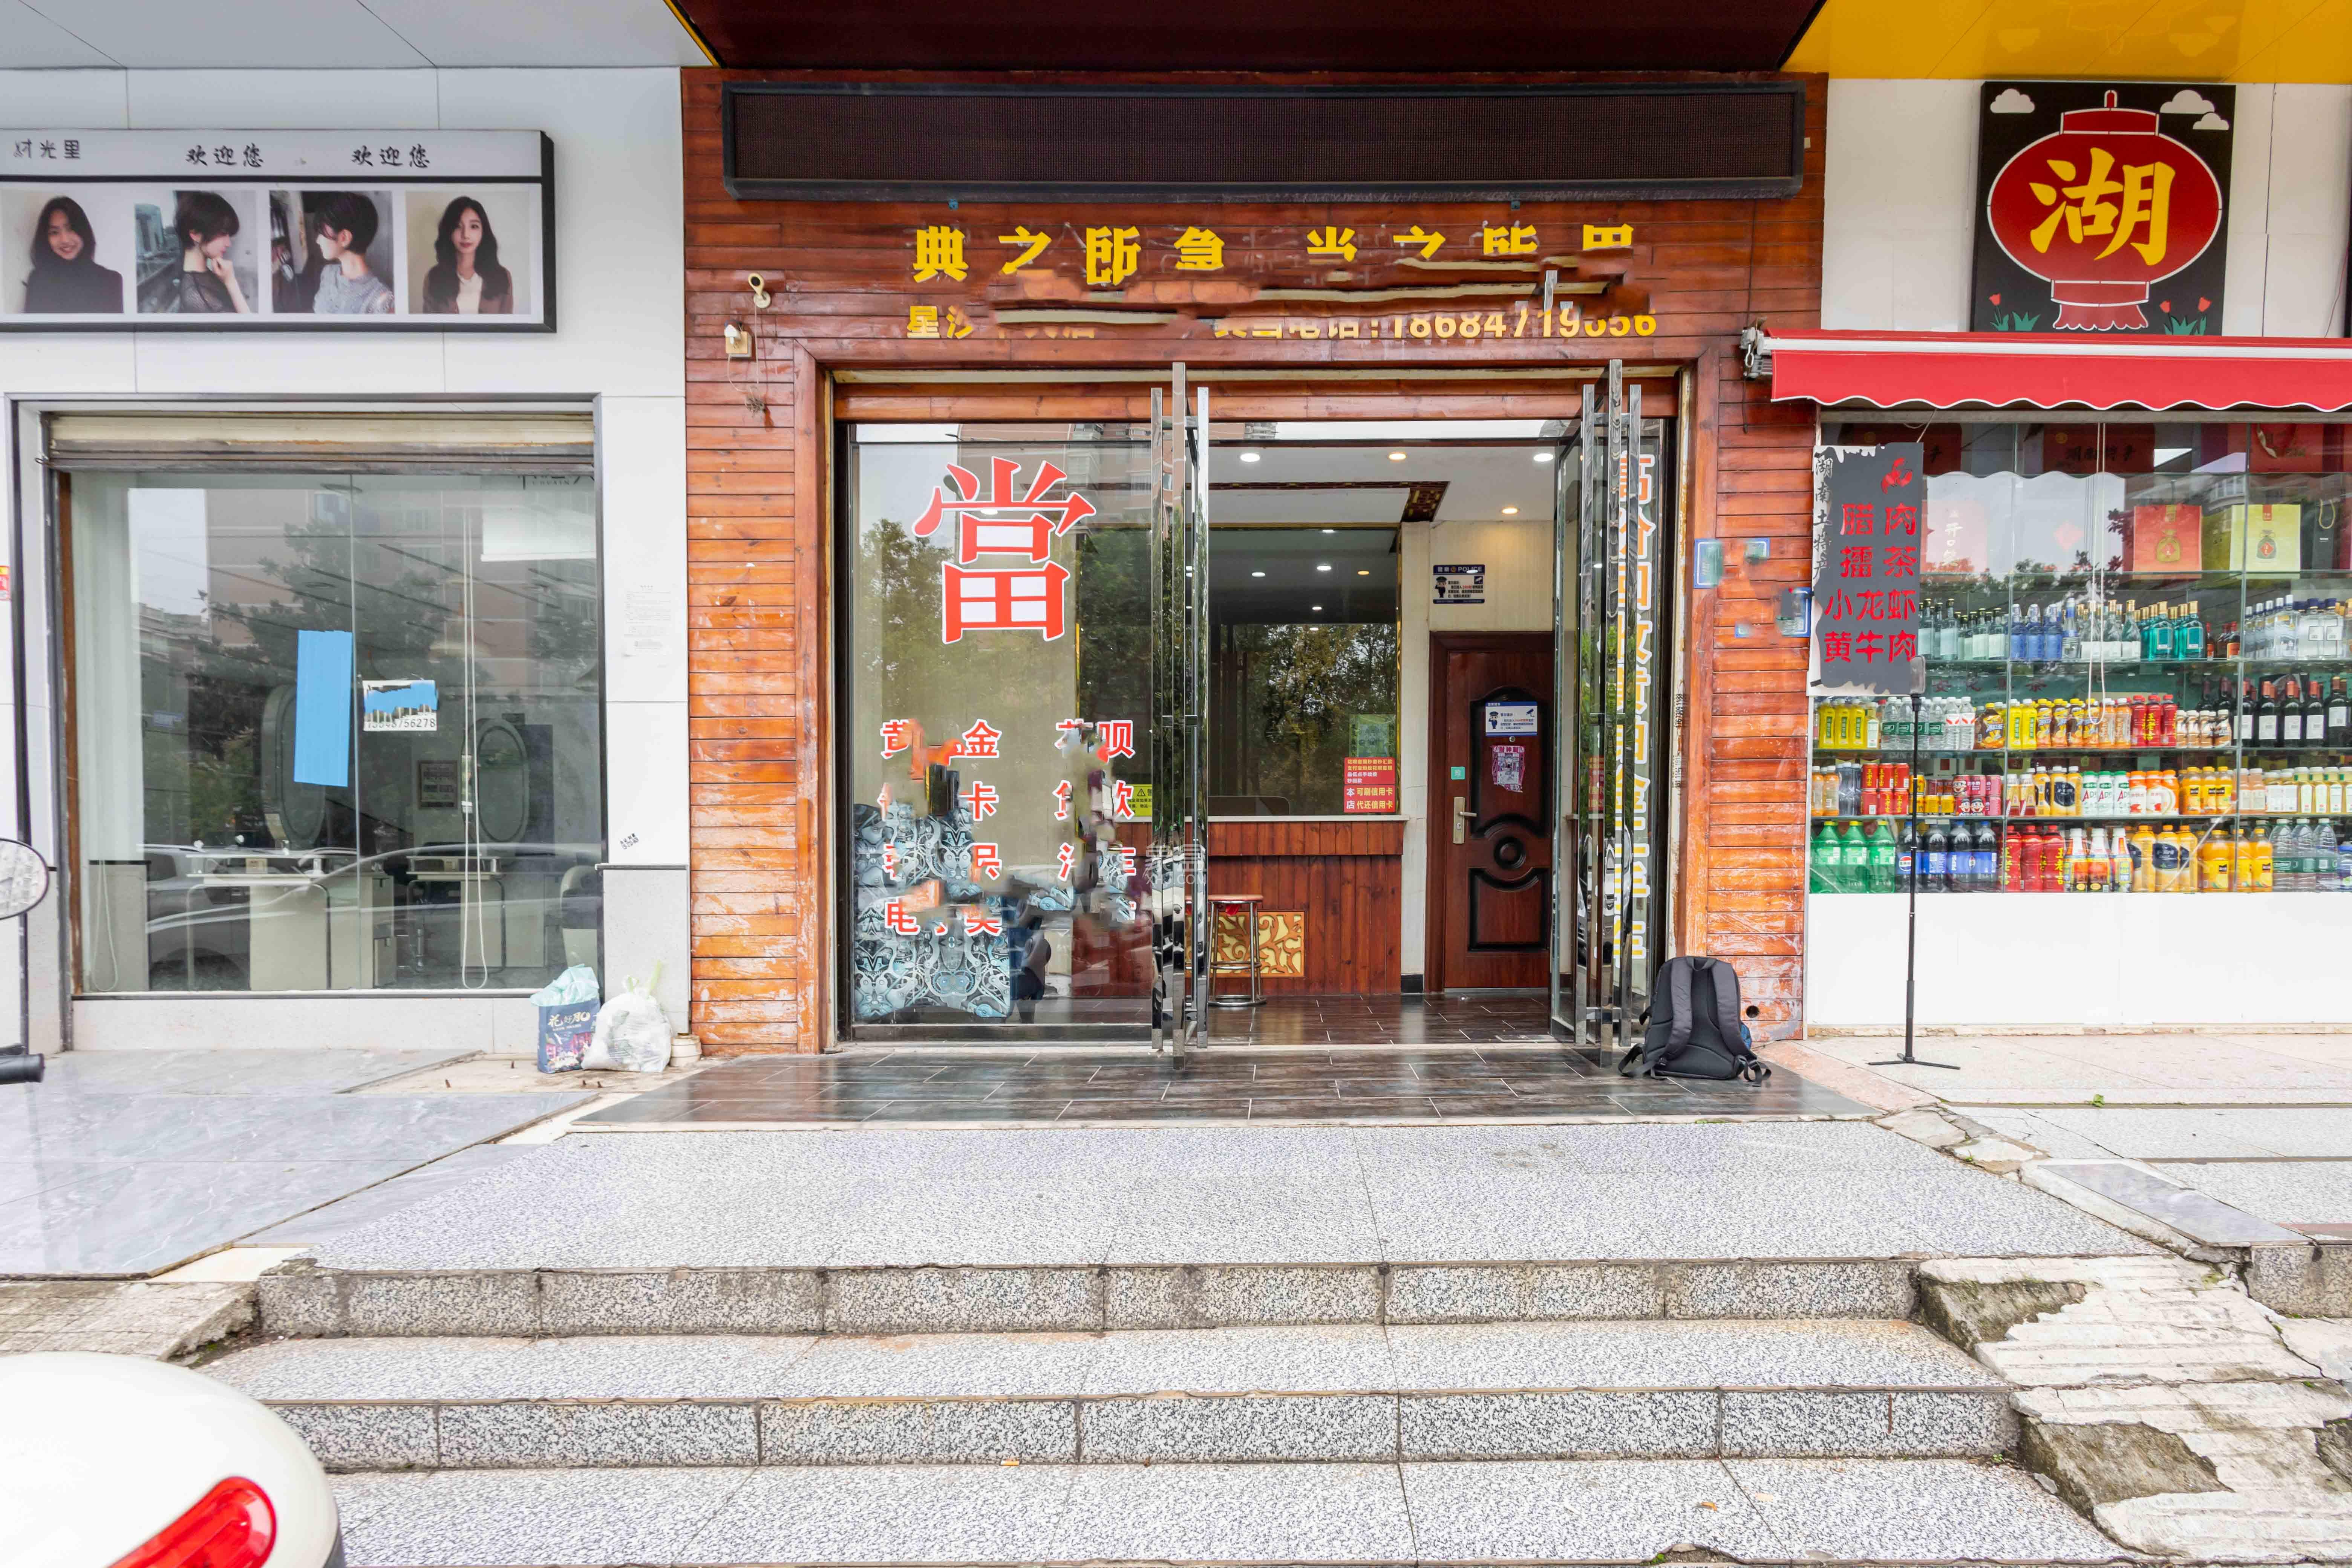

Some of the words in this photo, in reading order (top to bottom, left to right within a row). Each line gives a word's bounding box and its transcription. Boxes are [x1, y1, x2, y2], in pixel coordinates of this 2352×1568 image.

[186, 143, 263, 168] 欢迎您
[351, 144, 430, 168] 欢迎您
[2029, 147, 2176, 266] 湖
[1840, 502, 1917, 536] 腊肉
[912, 456, 1096, 643] 當
[1840, 545, 1917, 578] 擂茶
[1824, 588, 1916, 621] 小龙虾
[1824, 630, 1916, 664] 黄牛肉
[1346, 787, 1355, 797] 本
[1357, 787, 1393, 796] 可刷信用卡
[1346, 800, 1355, 810] 店
[1357, 800, 1394, 809] 代还信用卡
